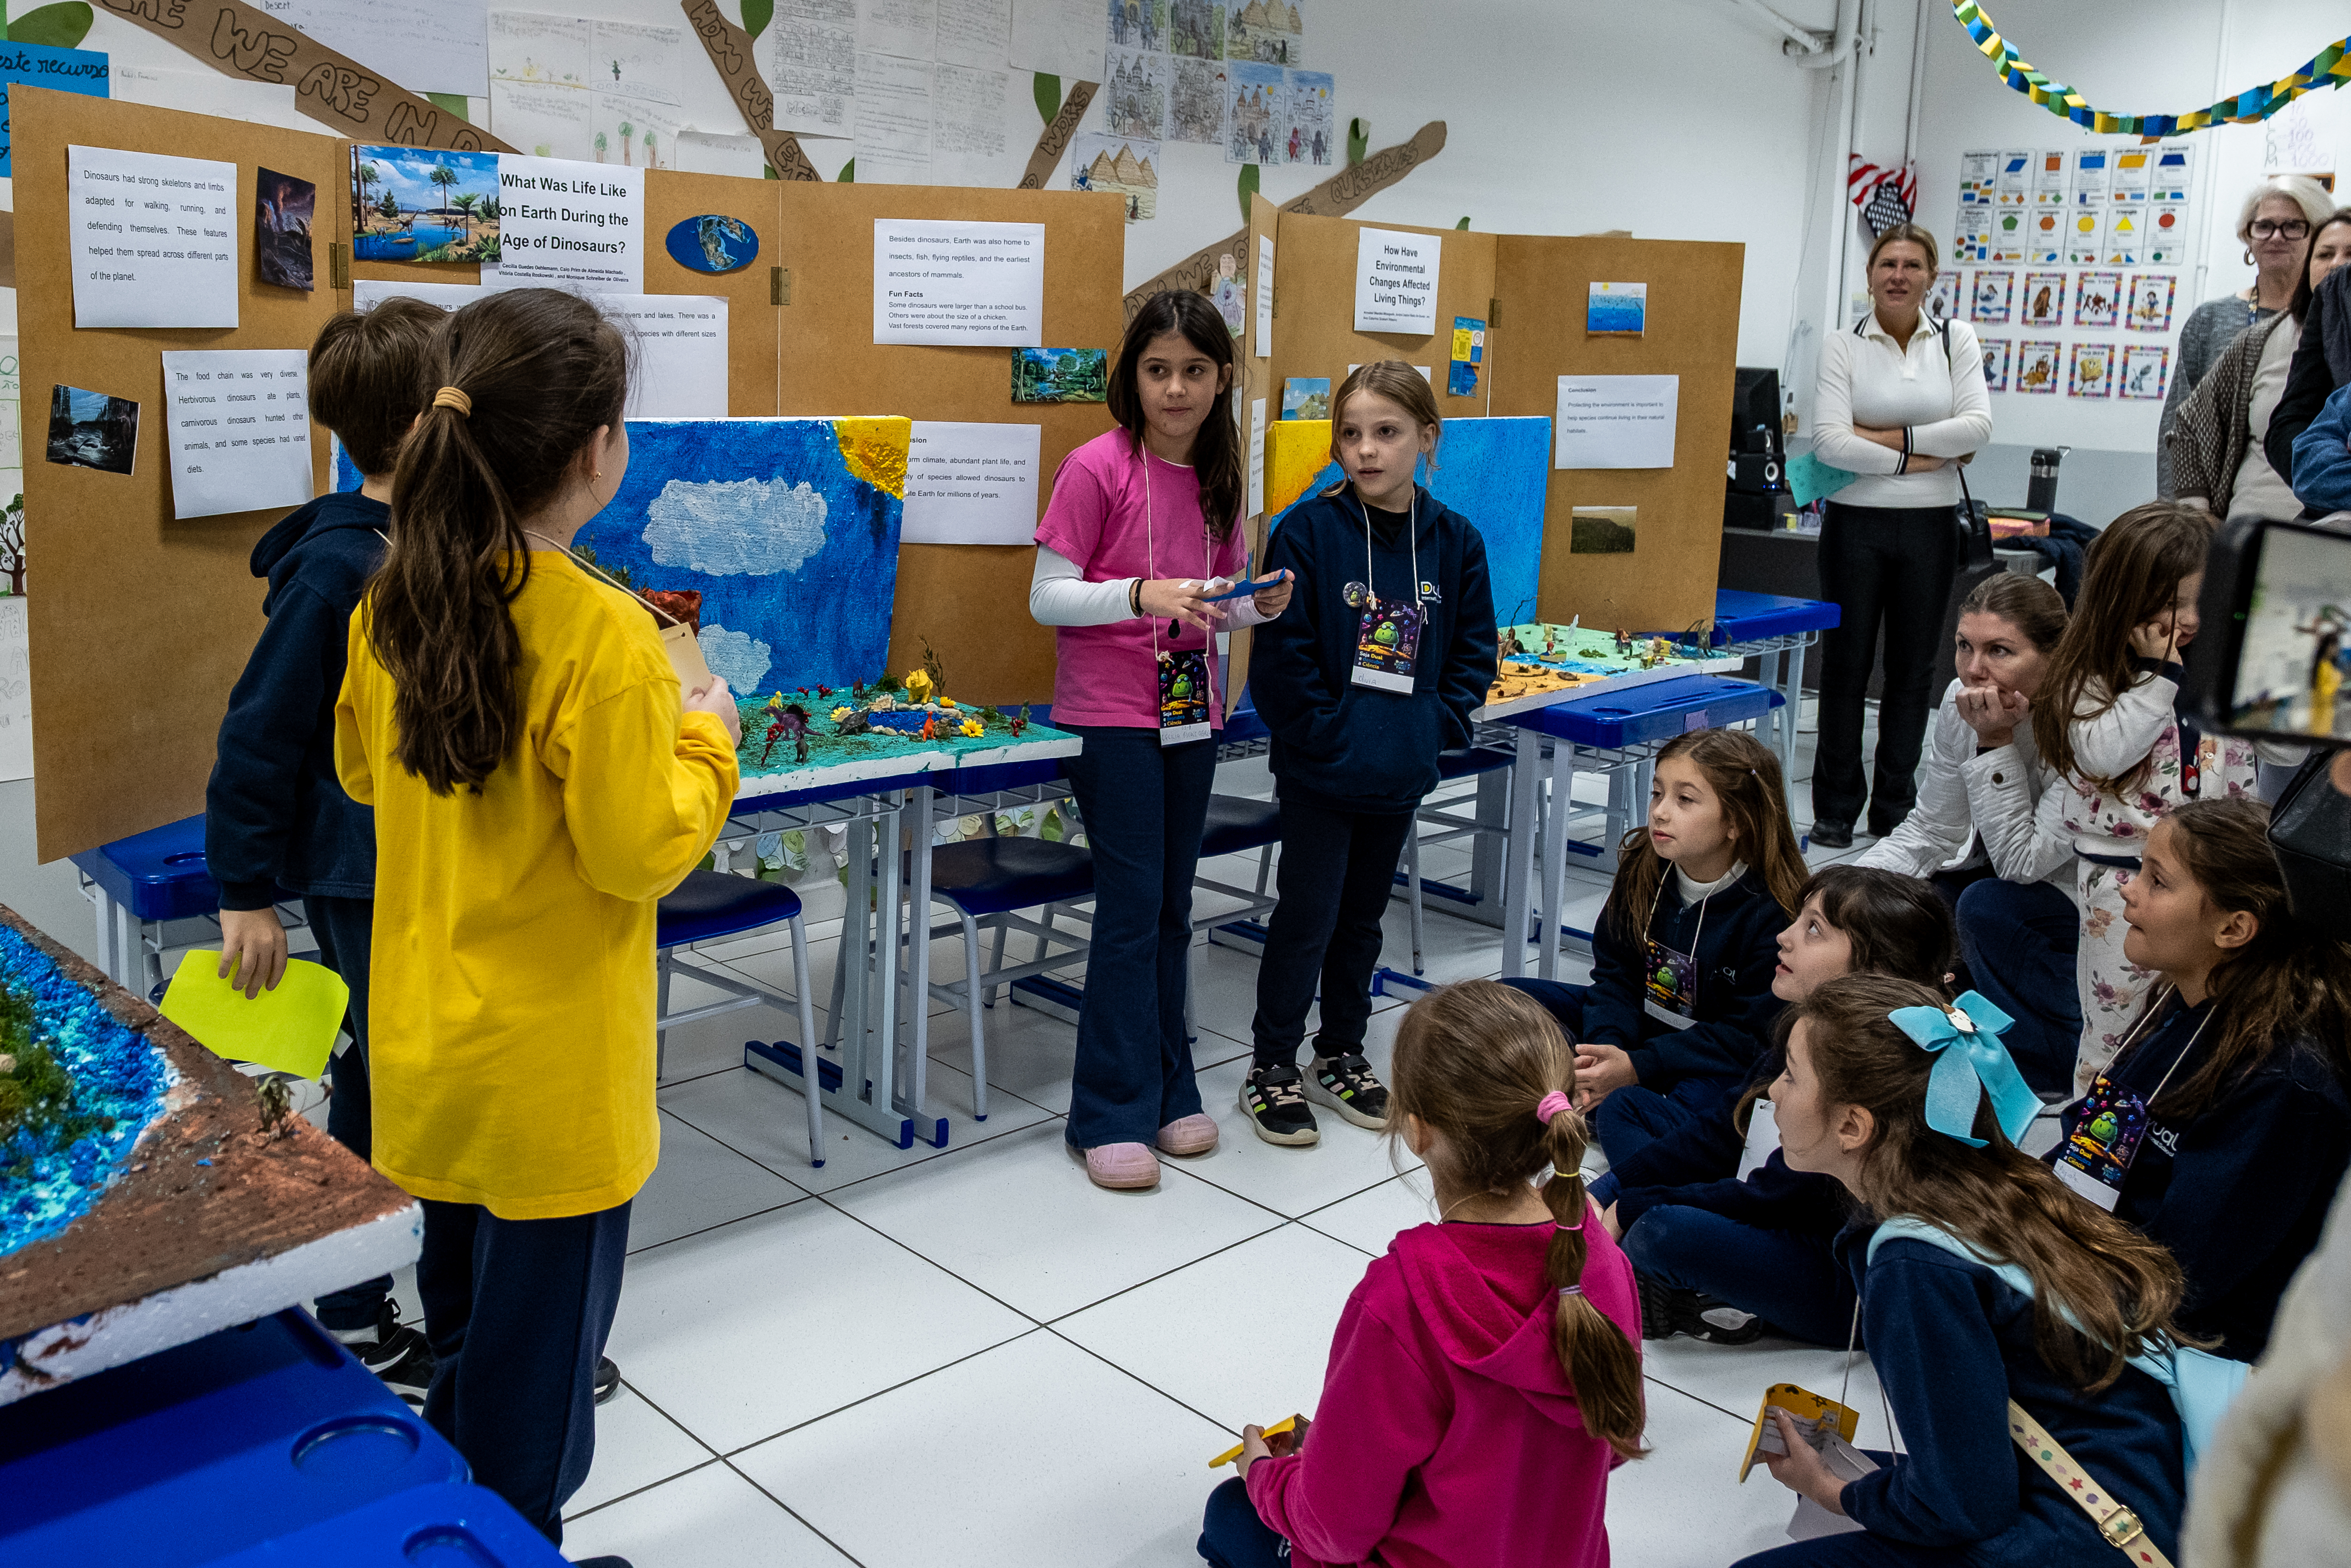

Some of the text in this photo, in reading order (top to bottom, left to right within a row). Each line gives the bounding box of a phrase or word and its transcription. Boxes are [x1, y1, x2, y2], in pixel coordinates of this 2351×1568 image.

[690, 1, 743, 75] HOW
[38, 59, 109, 79] recurso
[211, 8, 297, 83] WE
[297, 62, 380, 123] ARE
[1040, 86, 1090, 156] WORKS
[1331, 141, 1419, 203] OURSELVES
[84, 170, 225, 192] Dinosaurs had strong skeletons and limbs
[500, 173, 627, 198] What Was Life Like
[85, 196, 226, 215] adapted for walking, running, and
[499, 204, 628, 227] on Earth During the
[87, 221, 227, 238] defending themselves. These features
[502, 233, 626, 254] Age of Dinosaurs?
[1384, 245, 1418, 258] How Have
[88, 246, 113, 257] helped
[116, 247, 134, 256] them
[137, 249, 160, 259] spread
[187, 250, 213, 260] different
[215, 254, 229, 262] parts
[932, 254, 949, 262] flying
[1376, 260, 1425, 274] Environmental
[90, 271, 137, 282] of the planet.
[1369, 276, 1430, 291] Changes Affected
[1374, 293, 1426, 308] Living Things?
[176, 372, 188, 381] The
[196, 372, 210, 380] food
[217, 371, 234, 379] chain
[178, 395, 216, 404] Herbivorous
[227, 394, 256, 402] dinosaurs
[181, 418, 217, 427] carnivorous
[264, 413, 285, 422] hunted
[184, 441, 210, 450] animals,
[215, 439, 227, 448] and
[252, 437, 276, 447] species
[293, 433, 306, 442] varied
[187, 464, 204, 473] diets.
